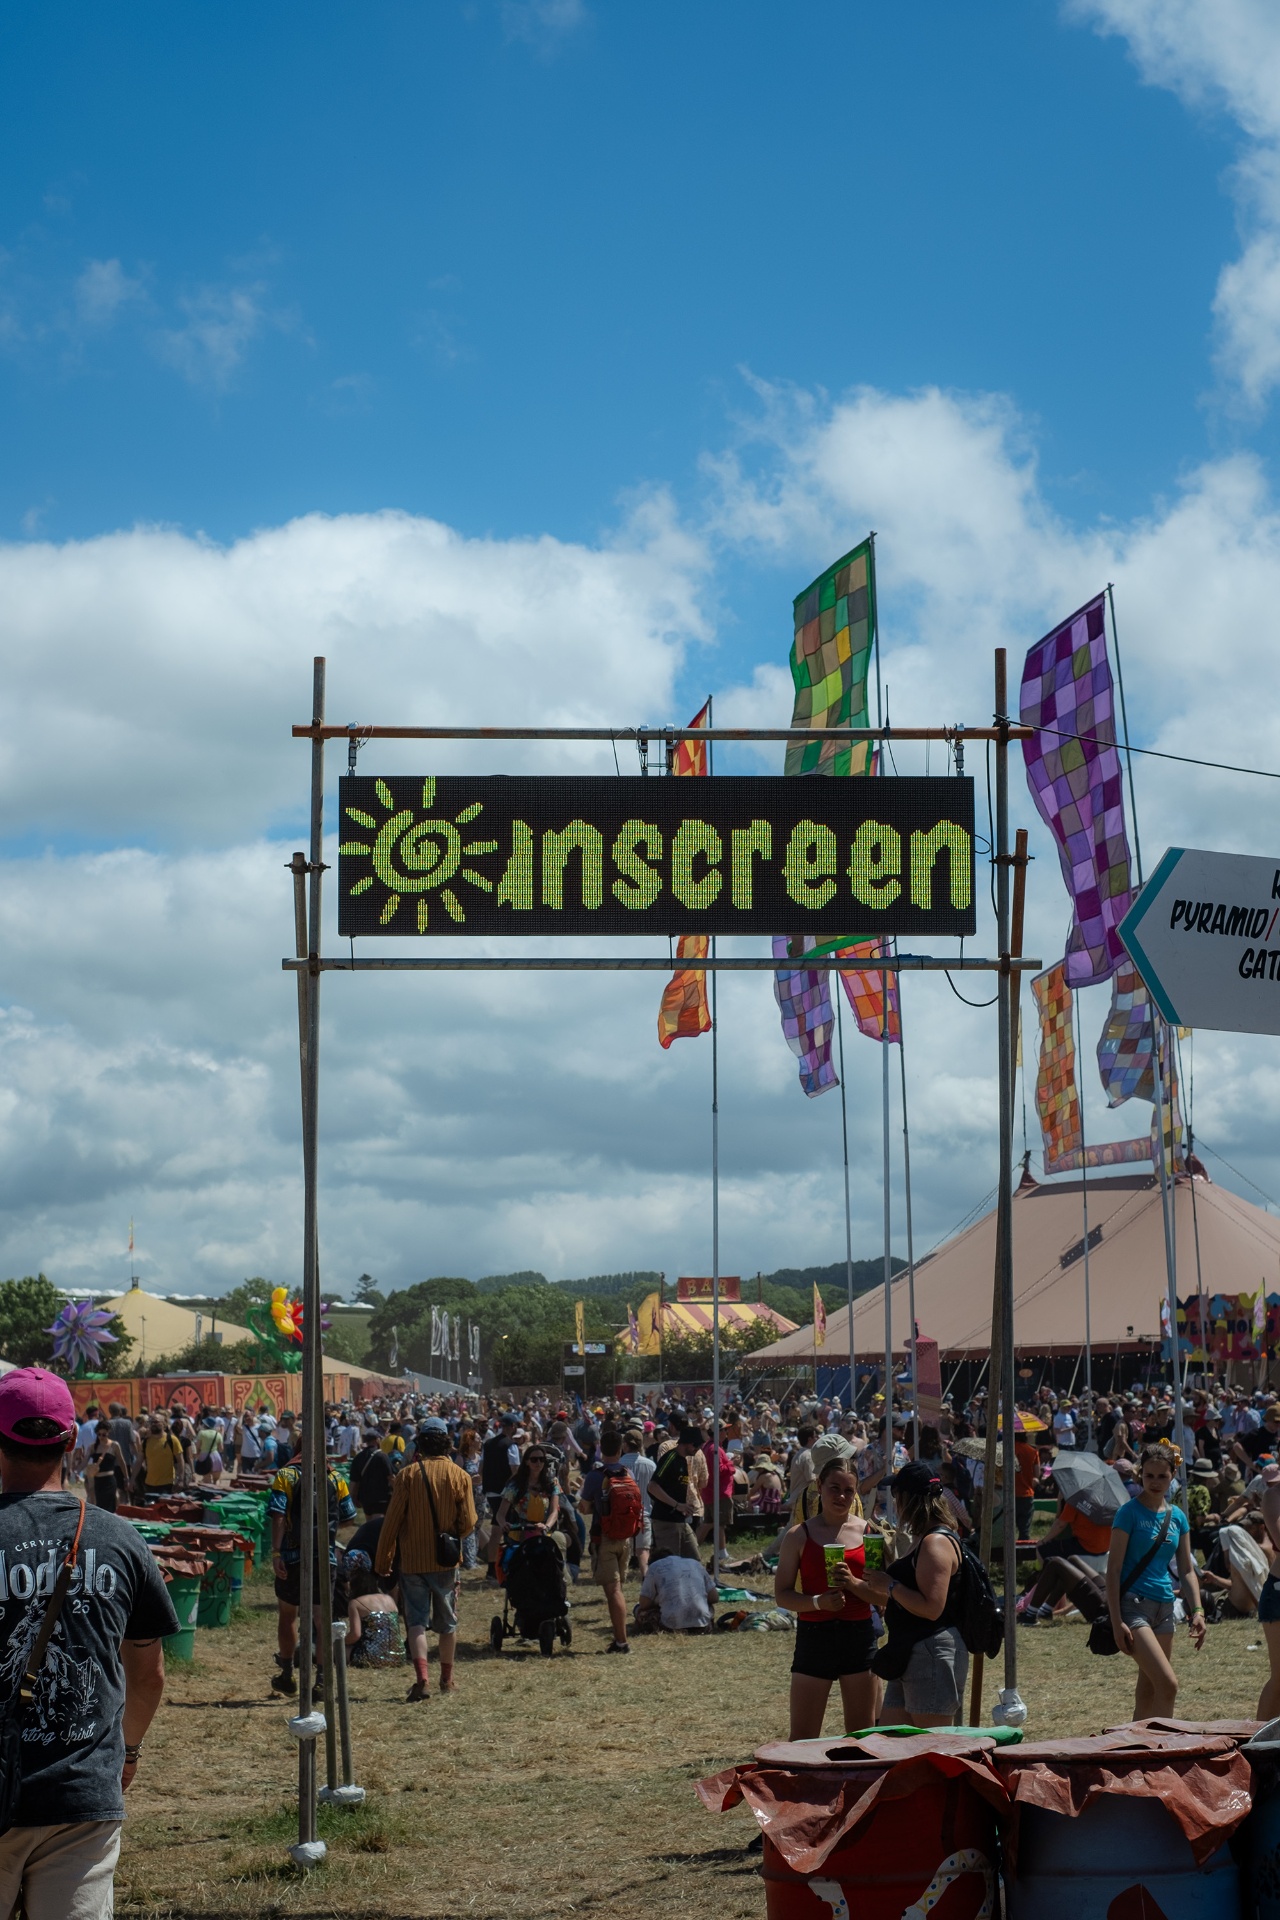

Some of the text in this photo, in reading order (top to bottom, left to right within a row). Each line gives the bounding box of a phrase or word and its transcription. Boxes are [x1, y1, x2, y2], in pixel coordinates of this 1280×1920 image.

[686, 1278, 727, 1297] BAR
[0, 1548, 117, 1602] odelo
[72, 1600, 90, 1614] 25
[59, 1720, 96, 1746] Spirit
